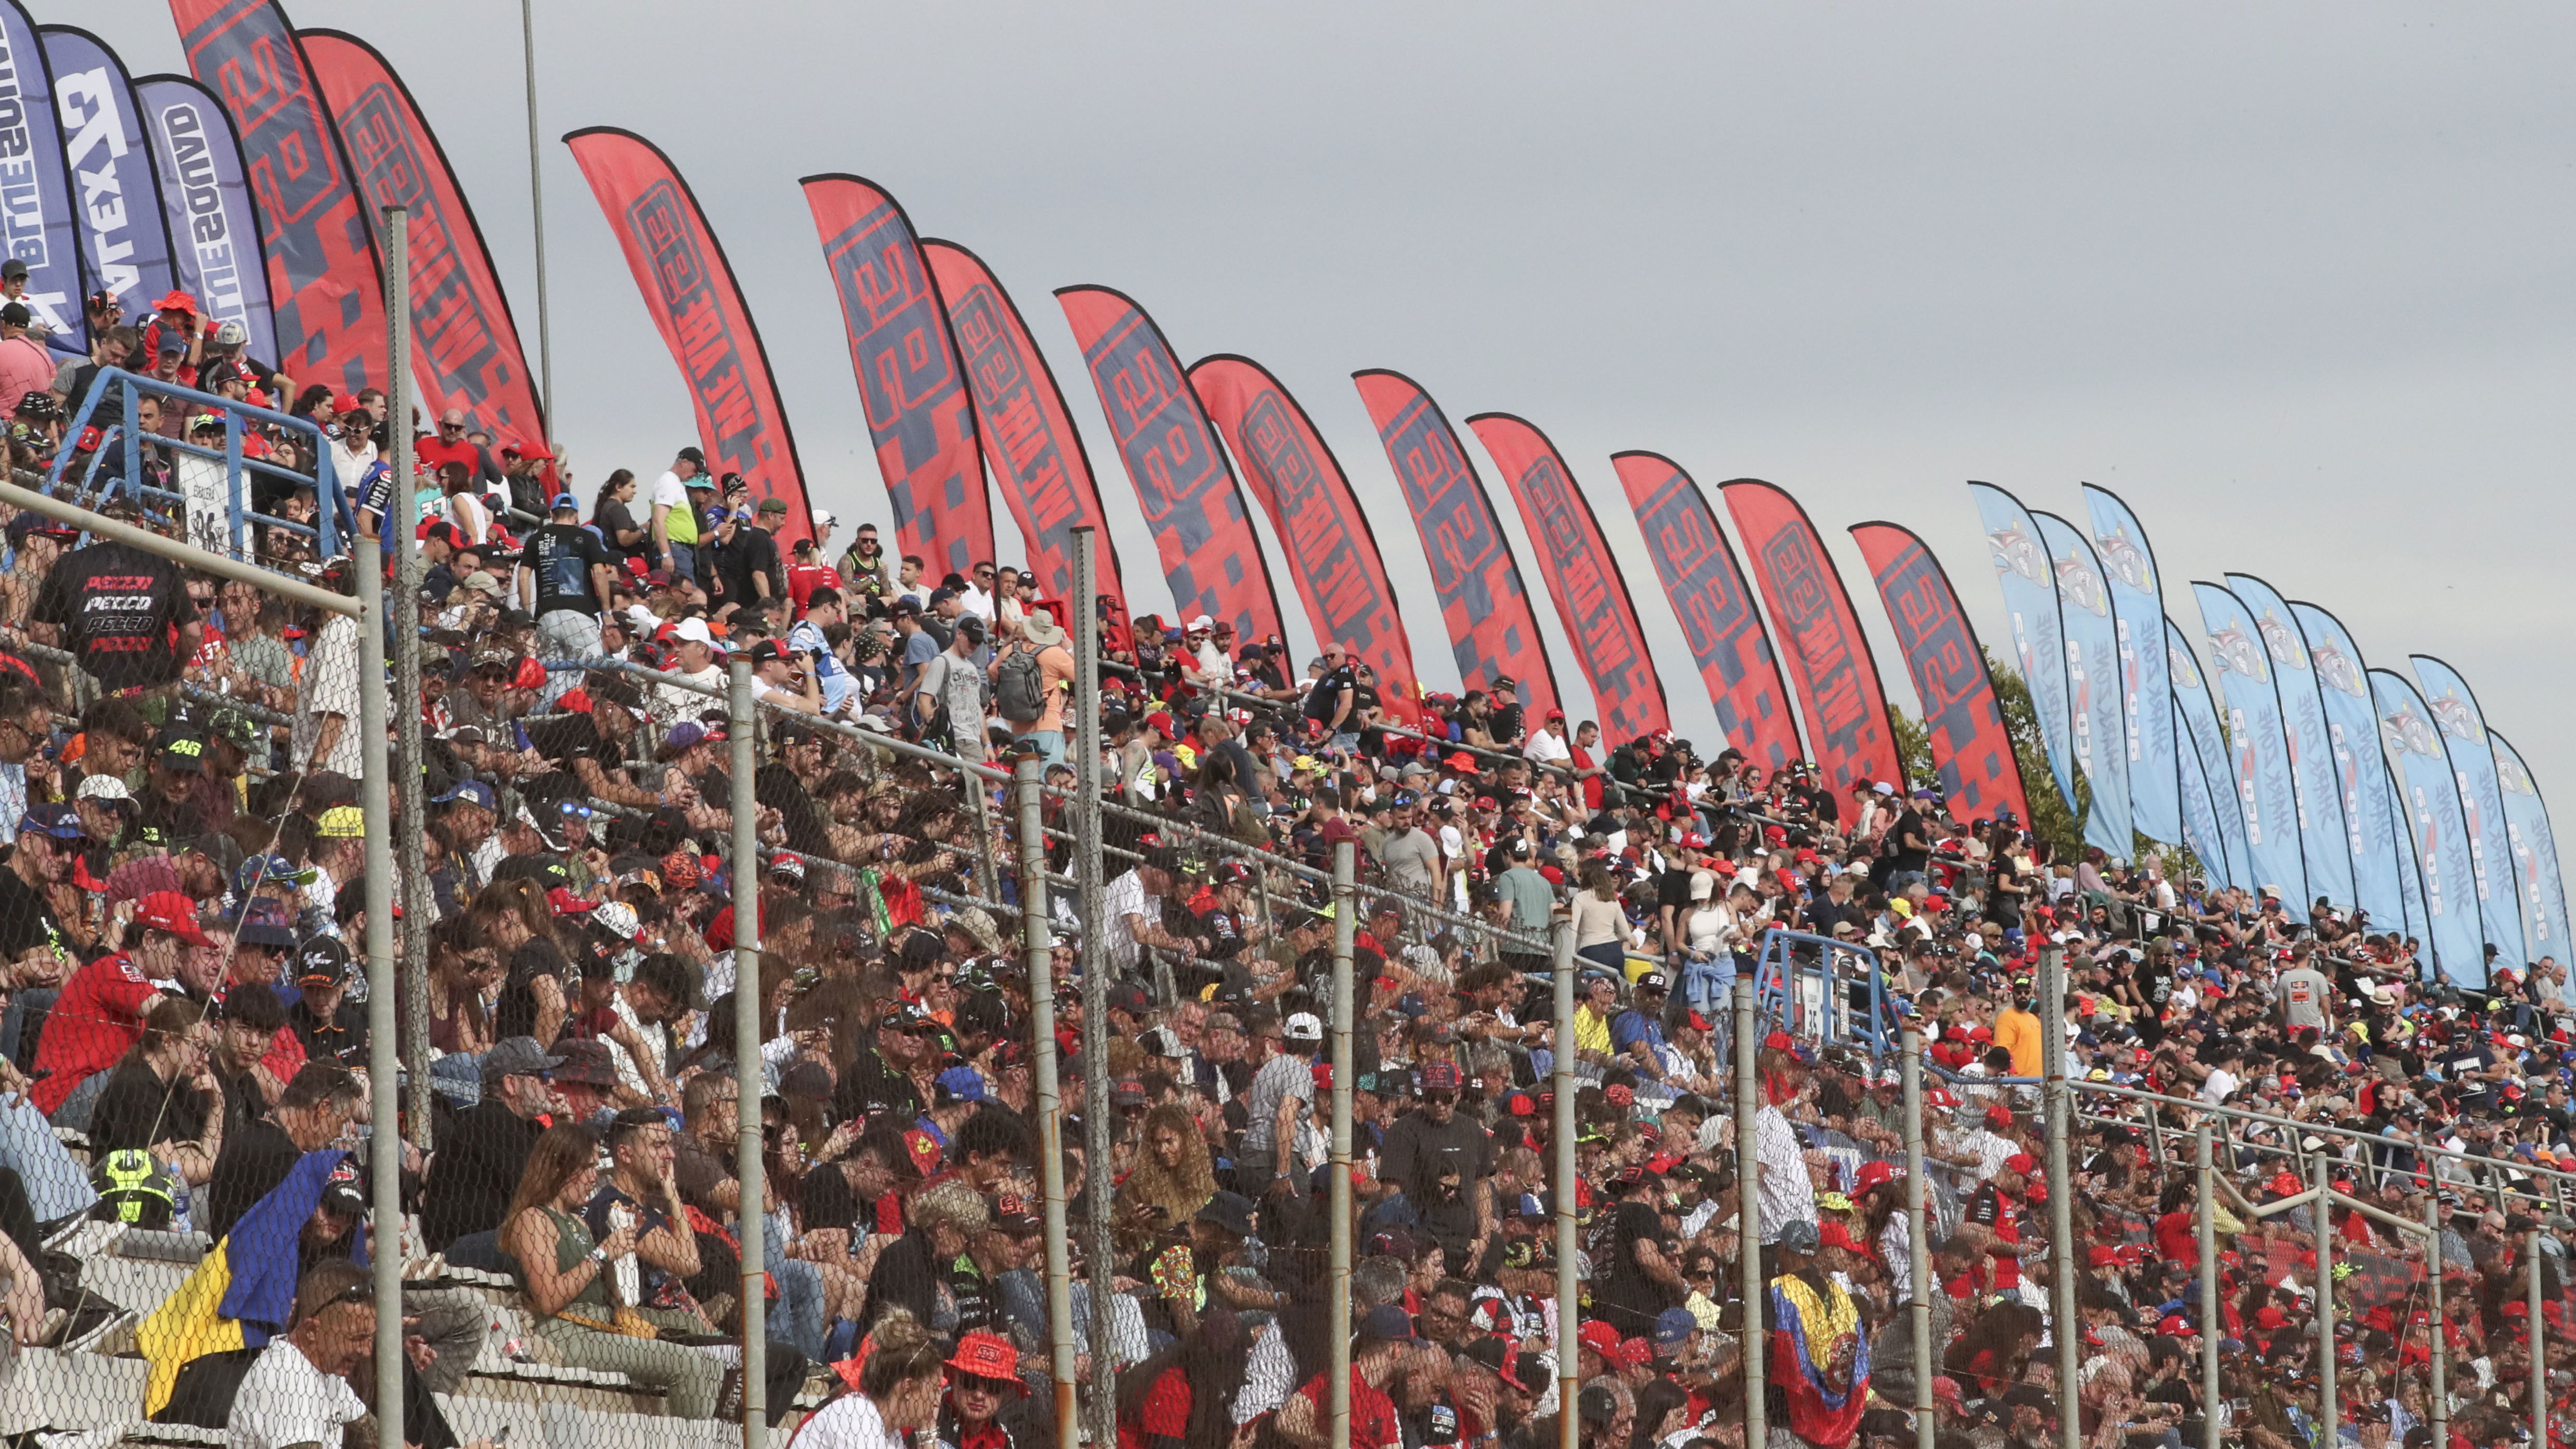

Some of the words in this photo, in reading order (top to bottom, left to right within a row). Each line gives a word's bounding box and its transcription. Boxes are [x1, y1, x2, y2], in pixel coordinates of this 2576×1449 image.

[83, 596, 153, 612] PECCO
[169, 739, 201, 757] 46
[548, 864, 566, 877] 46
[1648, 975, 1664, 985] 93
[2454, 1057, 2480, 1071] PUMA
